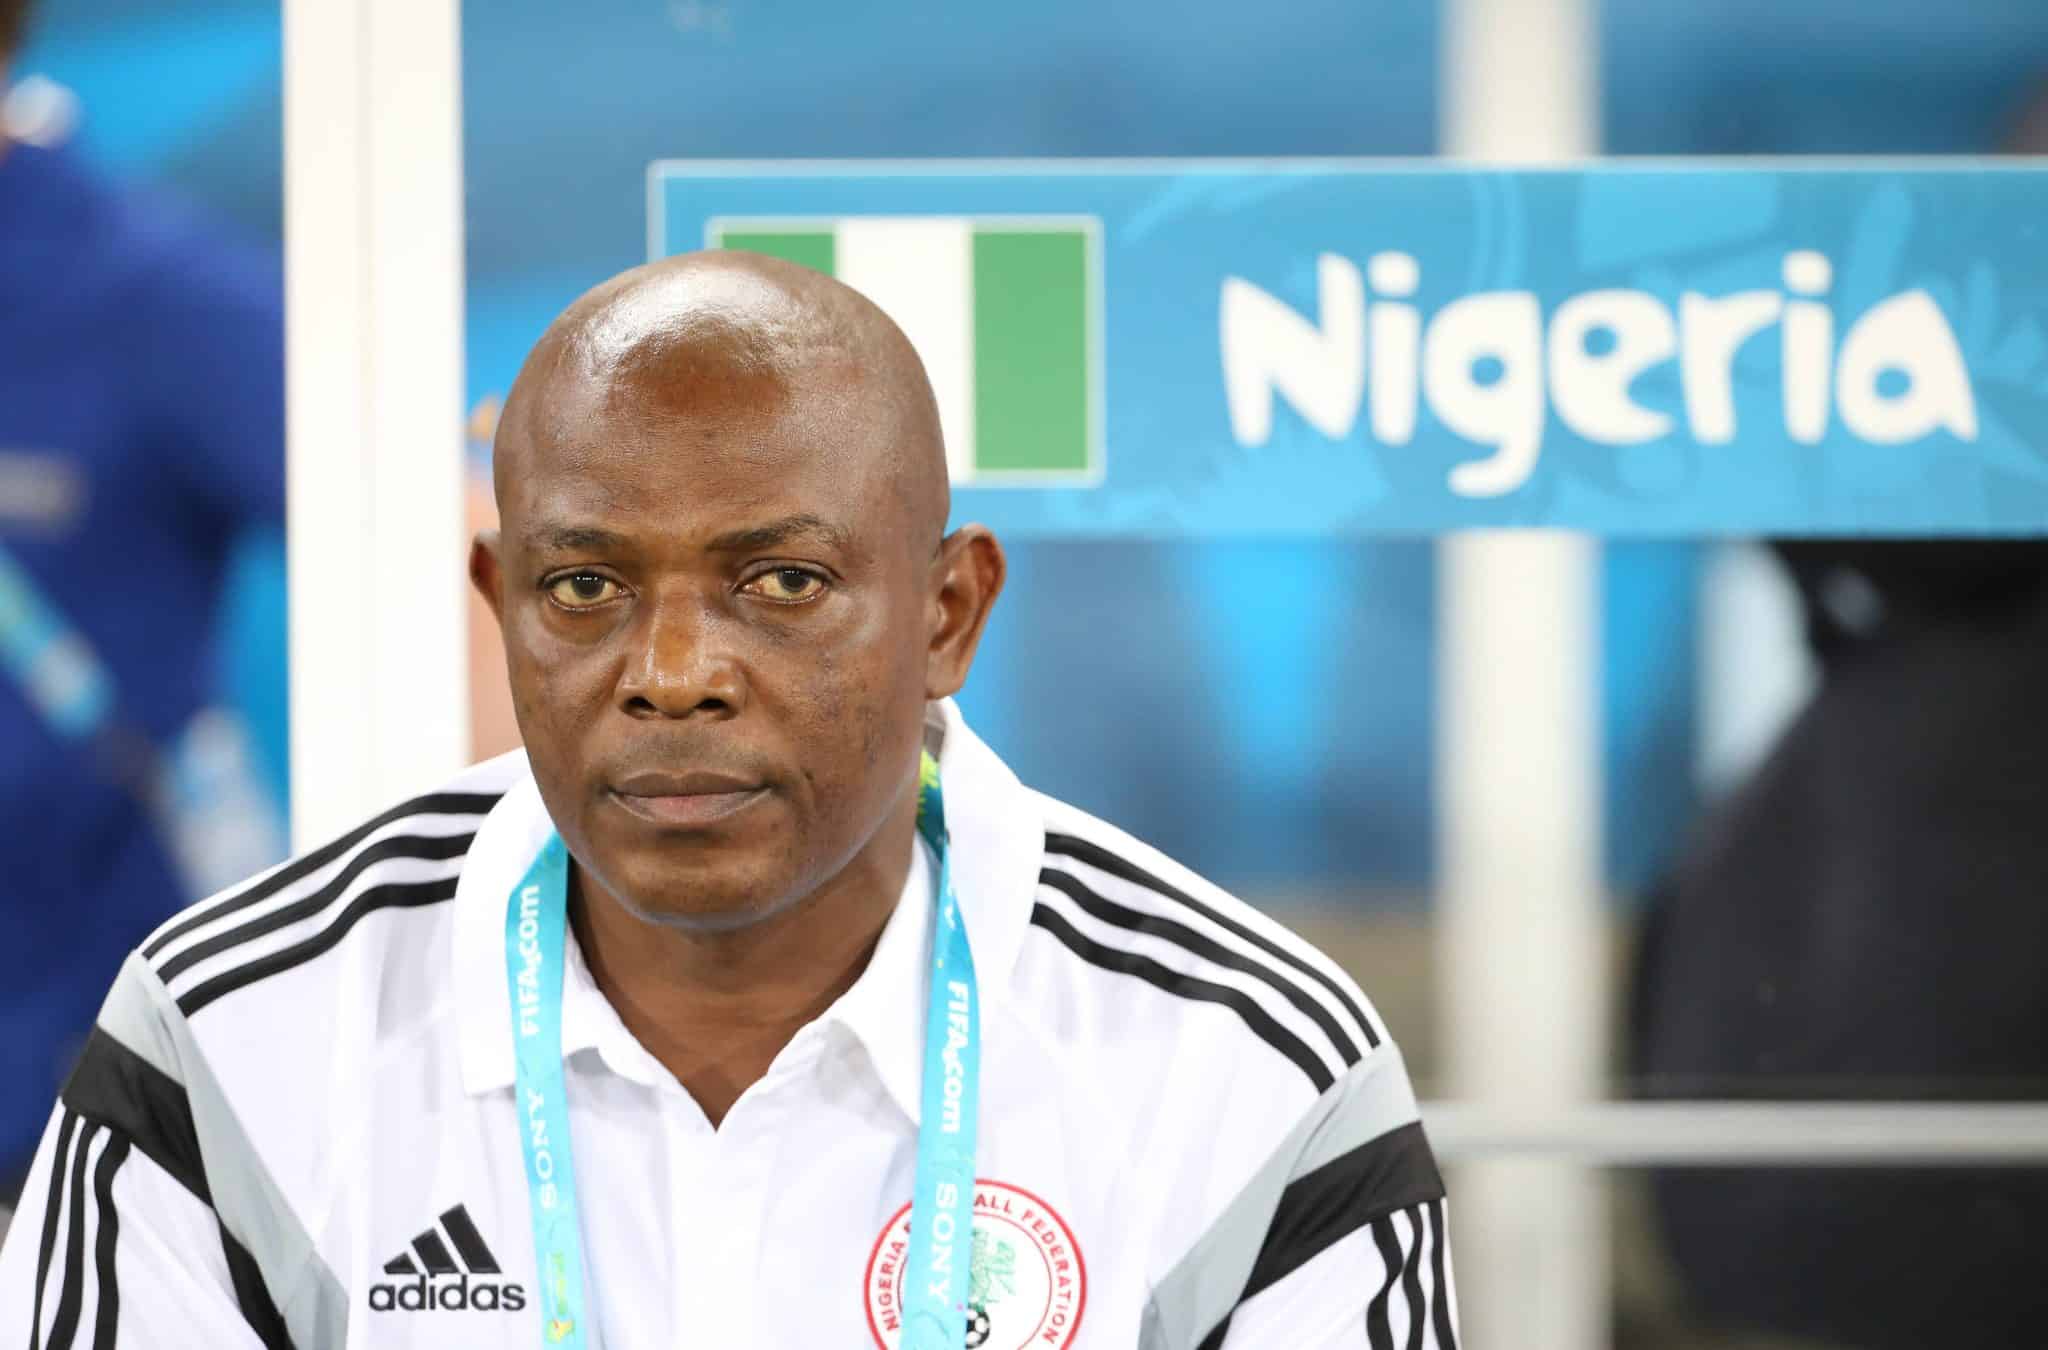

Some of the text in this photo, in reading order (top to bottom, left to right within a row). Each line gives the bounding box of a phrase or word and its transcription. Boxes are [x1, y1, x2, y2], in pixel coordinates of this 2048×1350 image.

[1220, 251, 1978, 498] Nigeria
[526, 1087, 558, 1209] SONY
[368, 1274, 526, 1312] adidas
[878, 1208, 1072, 1344] NIGERIA FEDERATION
[927, 1183, 958, 1307] SONY
